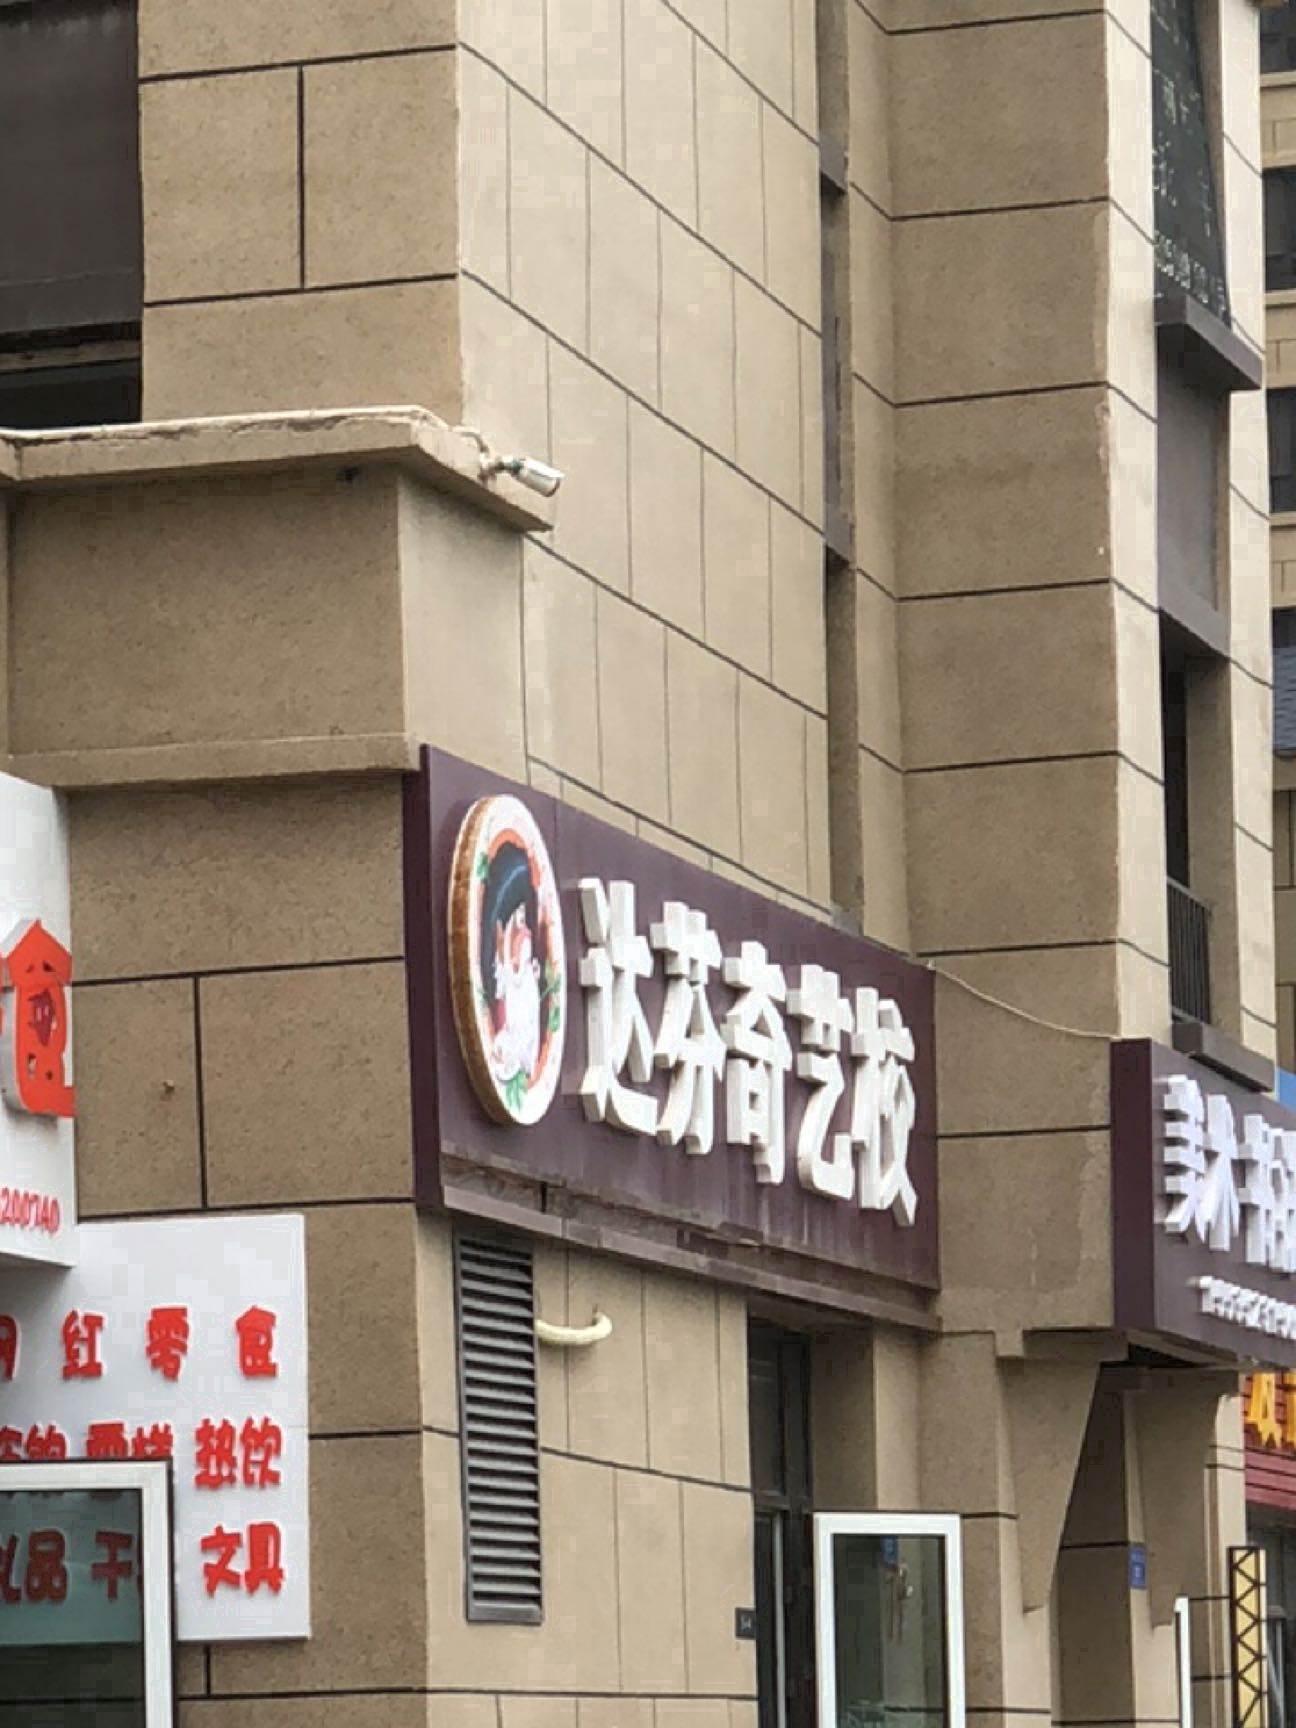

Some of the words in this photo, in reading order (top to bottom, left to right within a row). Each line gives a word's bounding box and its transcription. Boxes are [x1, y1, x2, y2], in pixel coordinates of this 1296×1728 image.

[578, 877, 917, 1226] 达芬奇艺校
[91, 1530, 142, 1601] 干
[201, 1522, 284, 1597] 文具
